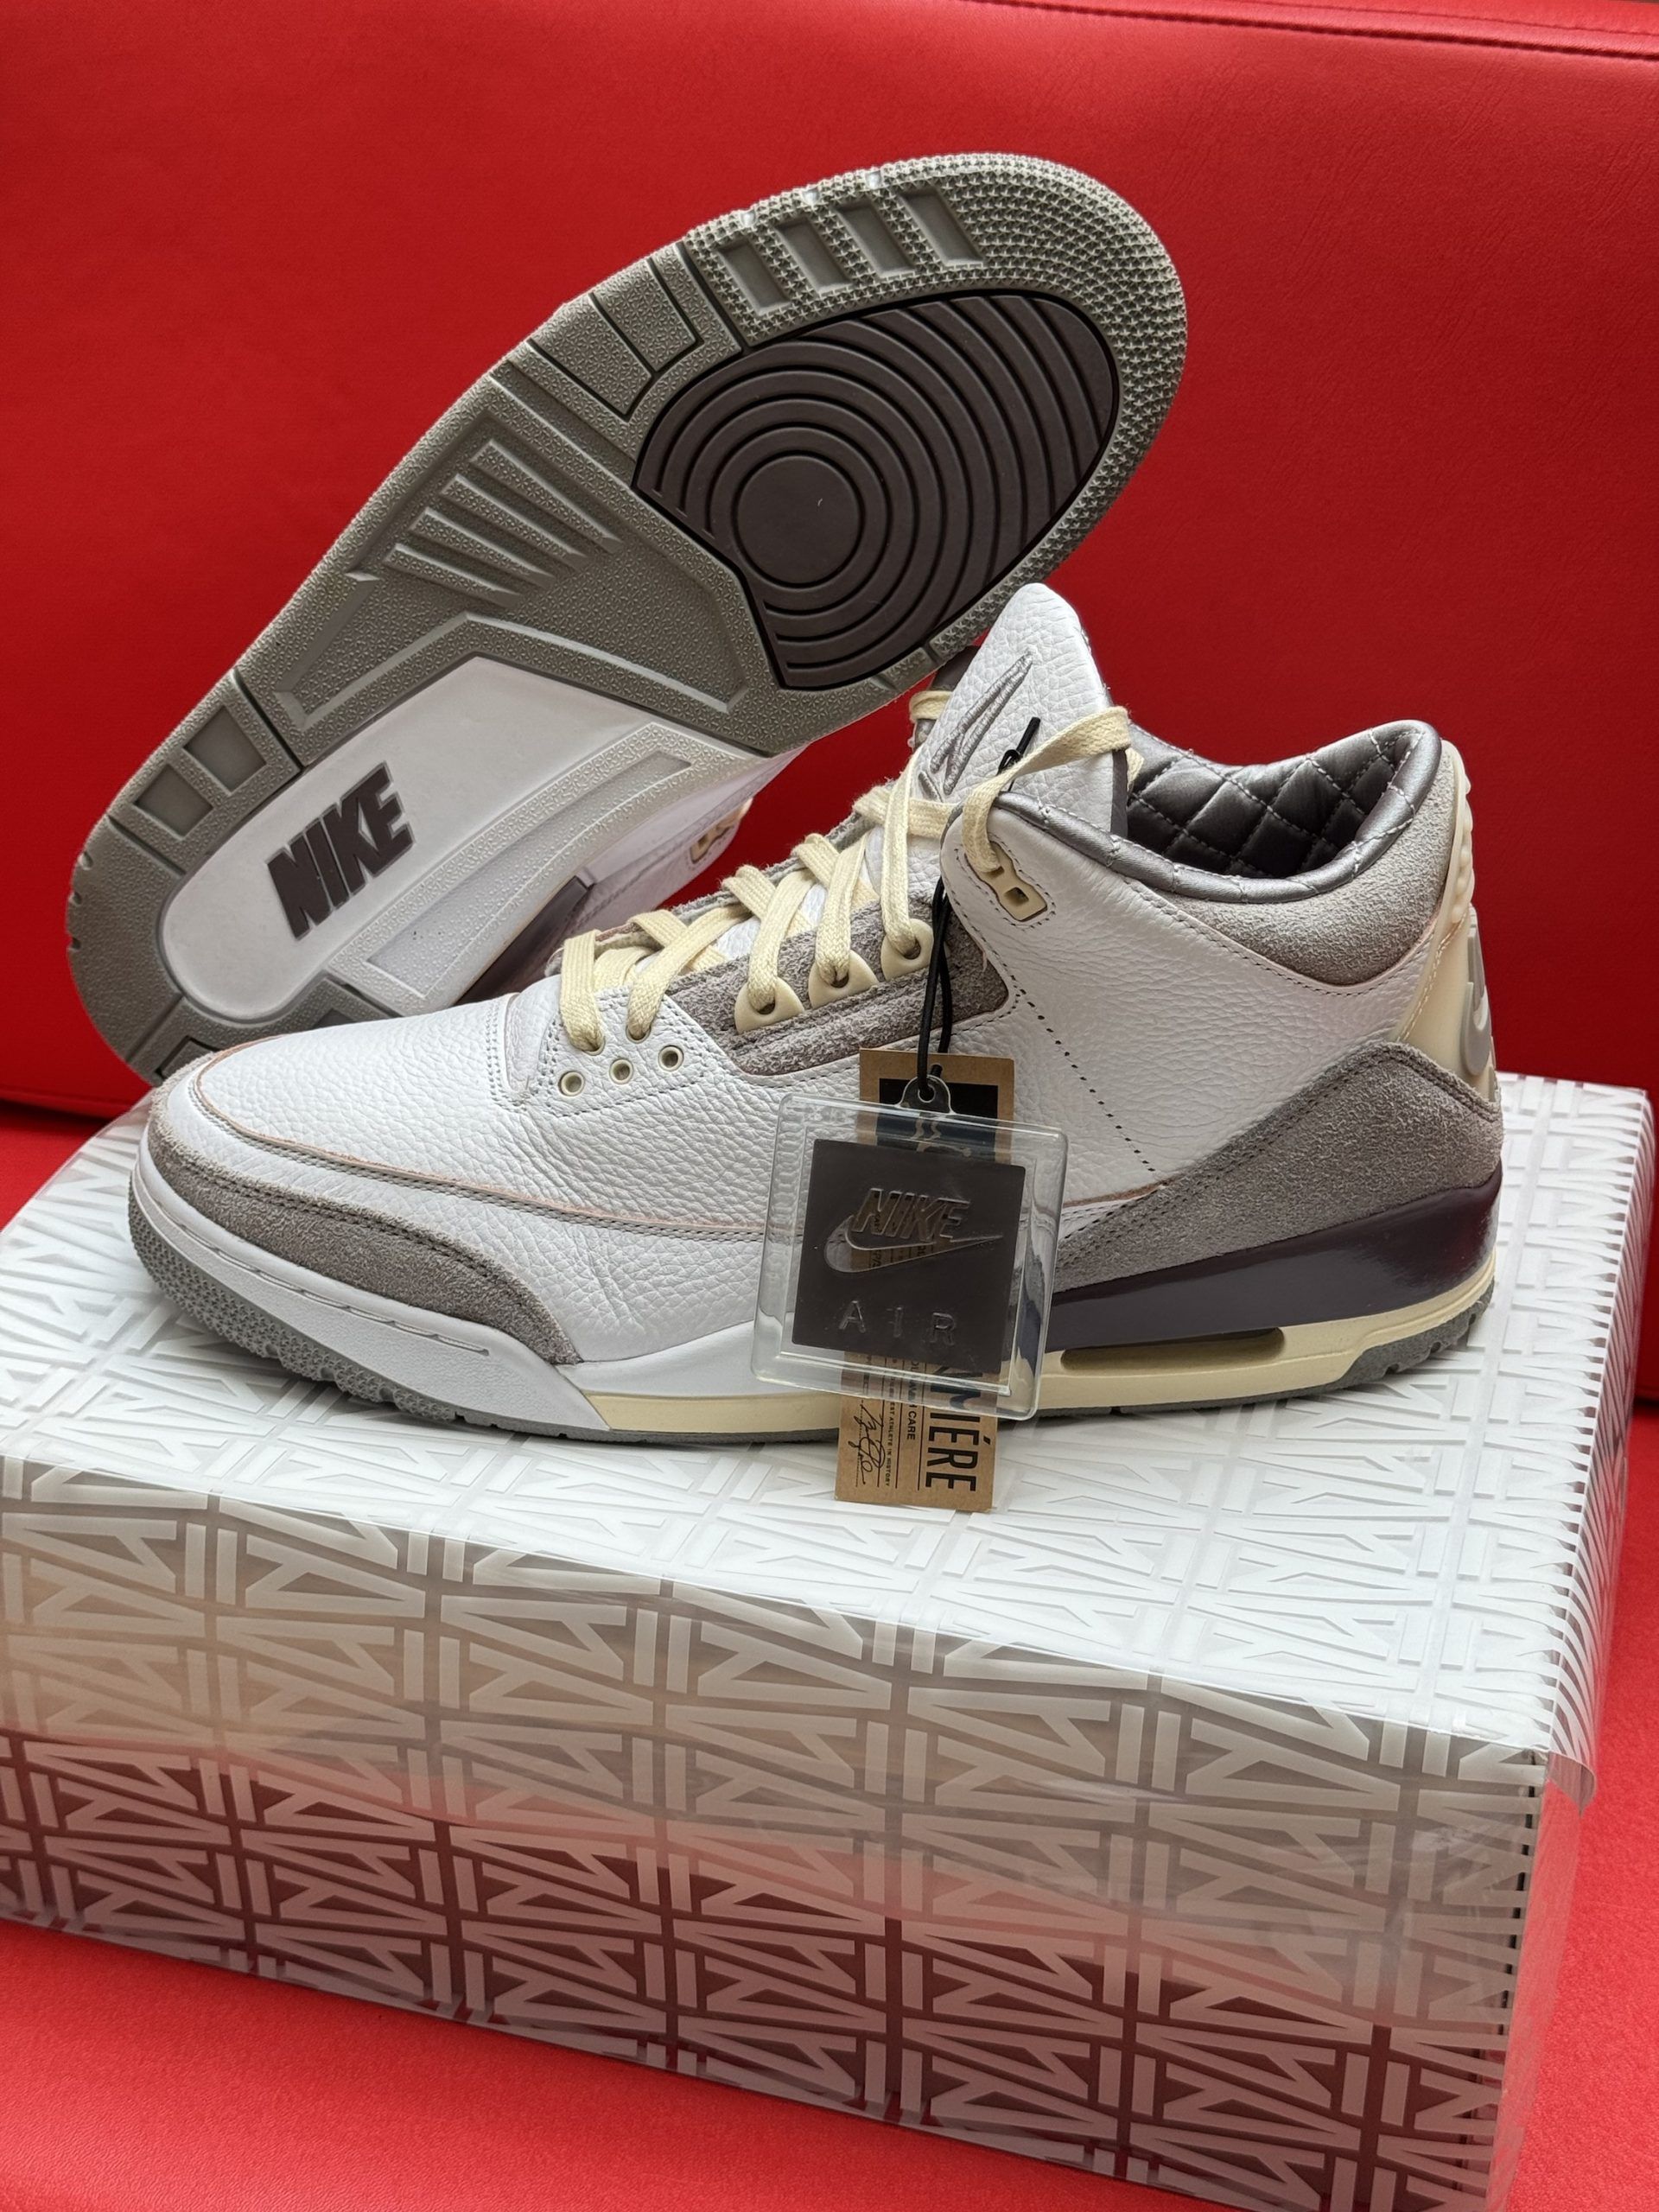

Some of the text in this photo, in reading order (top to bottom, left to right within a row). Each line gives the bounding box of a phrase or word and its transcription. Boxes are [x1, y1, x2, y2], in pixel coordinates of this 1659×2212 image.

[265, 760, 416, 941] NIKE
[850, 1187, 971, 1243] NIKE
[838, 1300, 957, 1346] AIR
[906, 1410, 917, 1440] CARE
